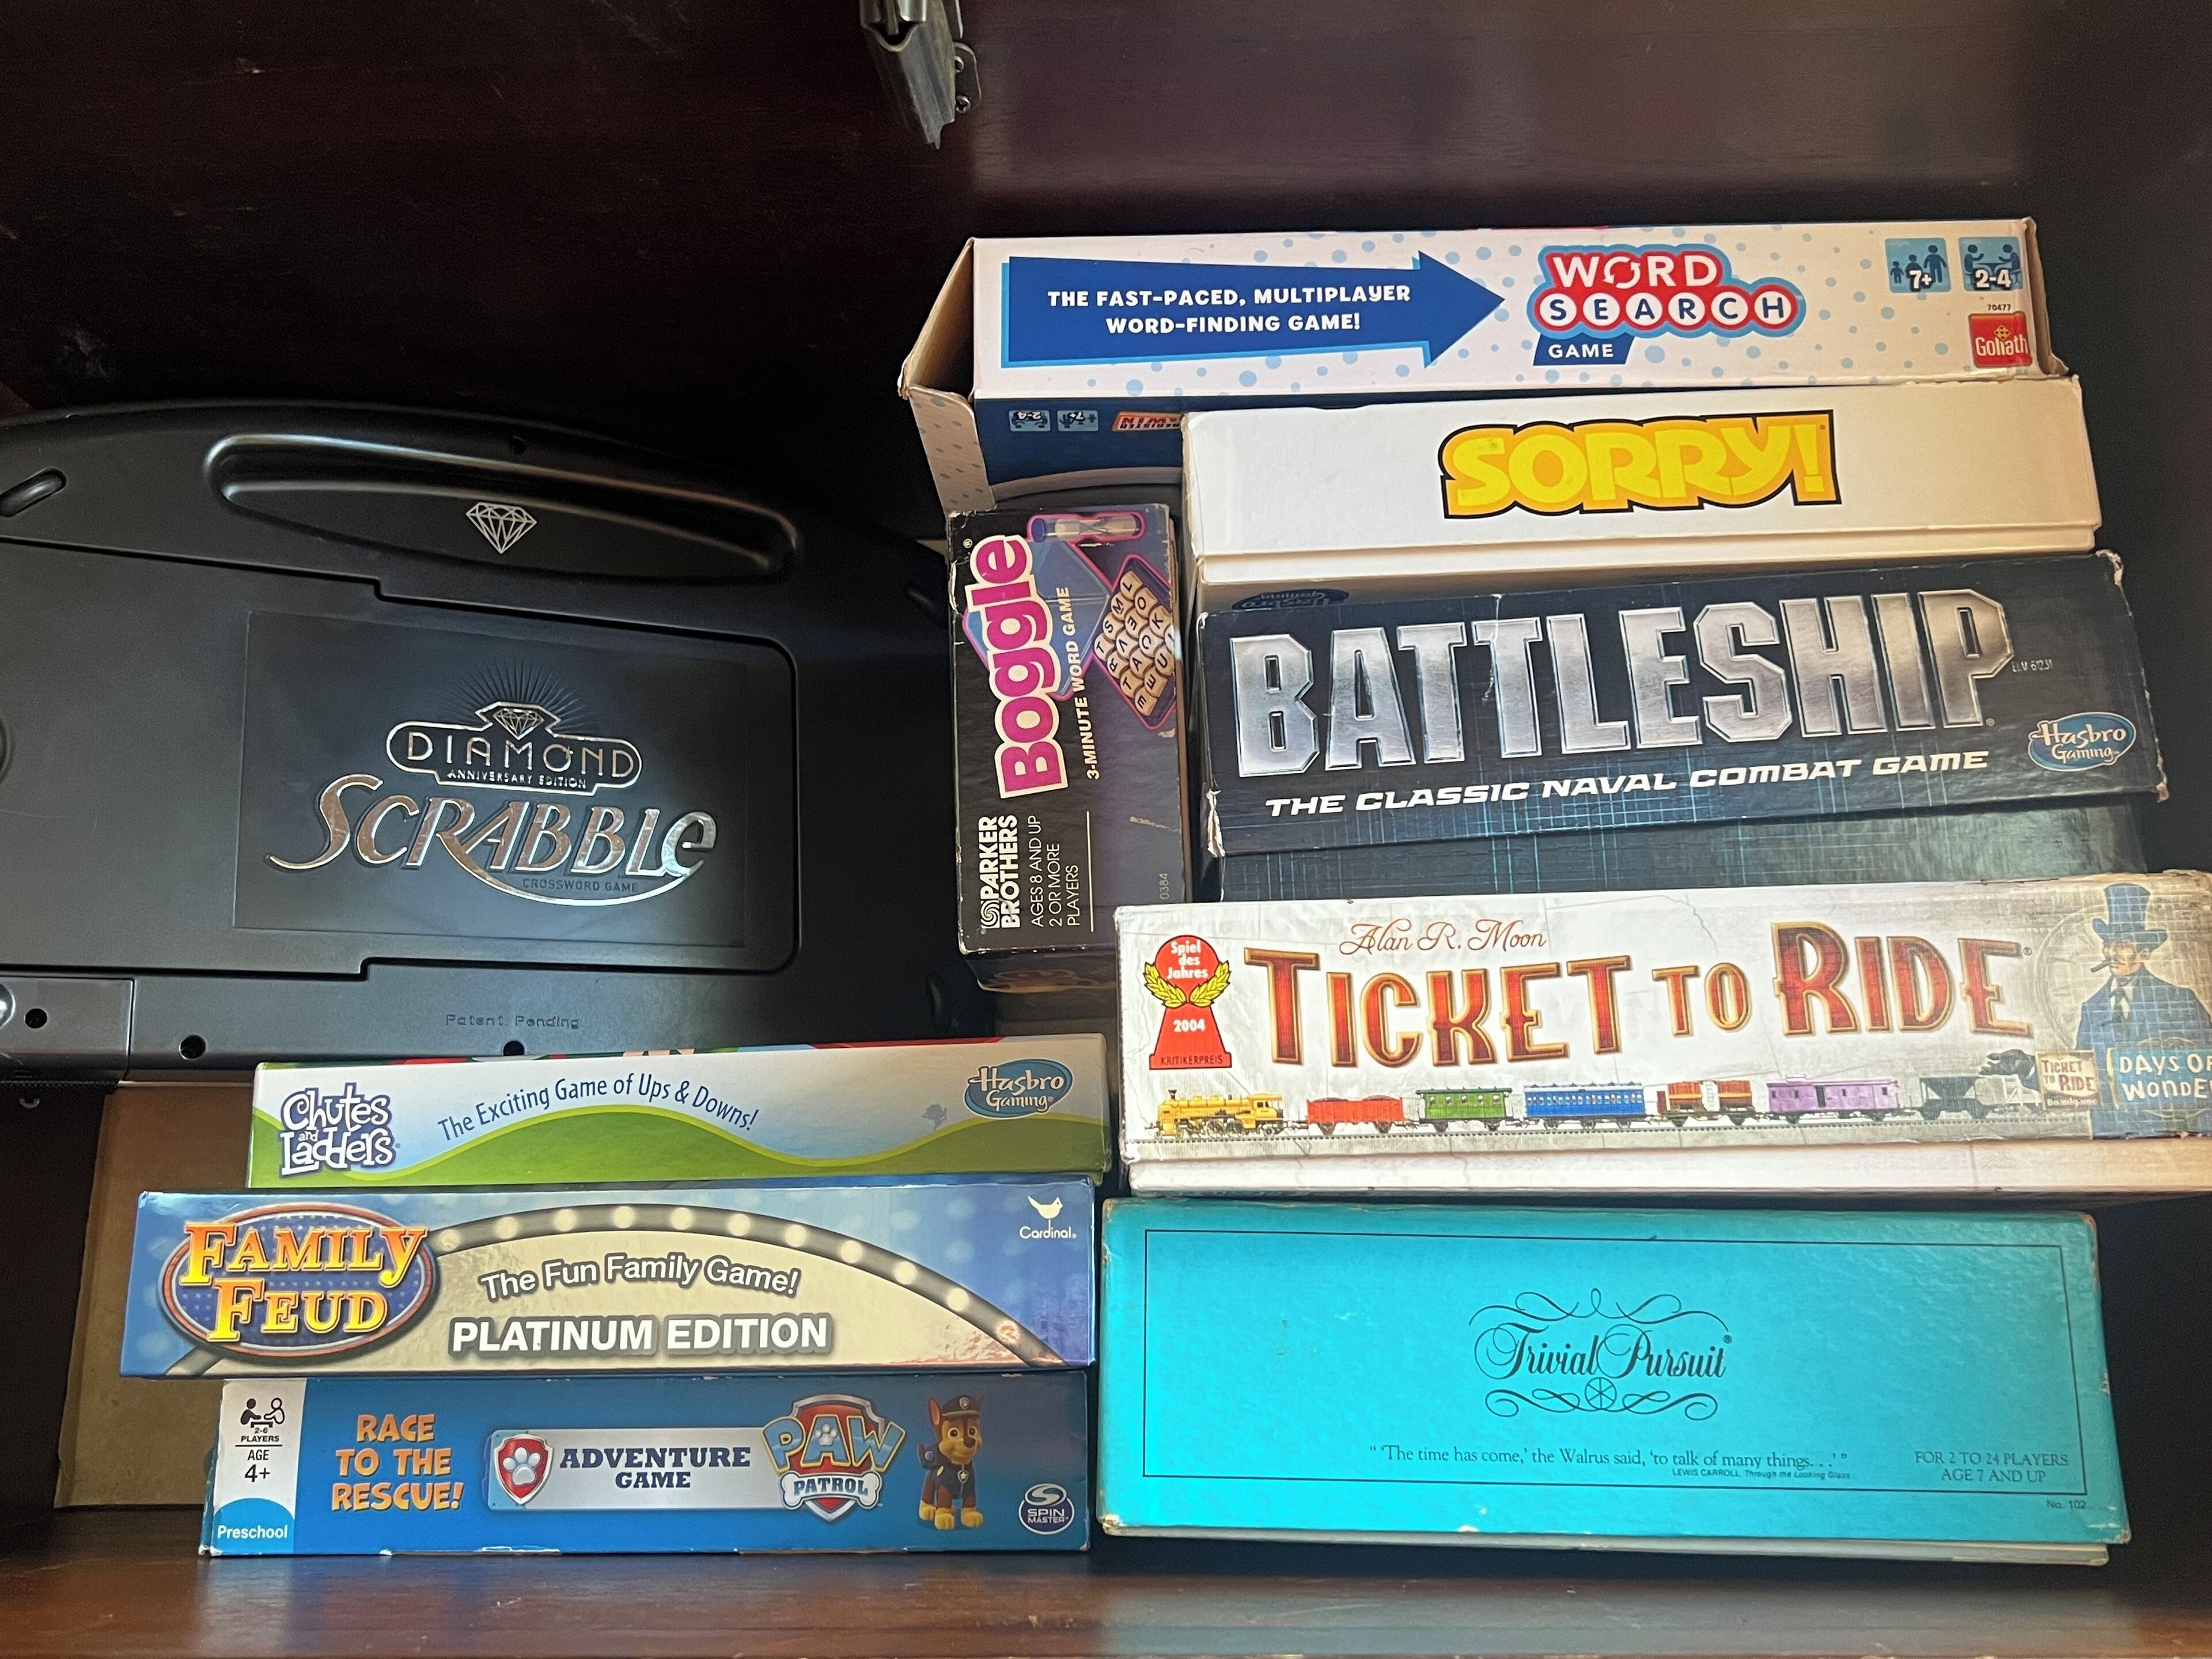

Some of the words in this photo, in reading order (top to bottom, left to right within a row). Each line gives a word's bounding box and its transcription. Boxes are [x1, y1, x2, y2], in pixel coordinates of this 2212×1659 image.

[1552, 252, 1718, 288] WORD
[1909, 270, 1932, 289] 7+
[1975, 268, 2012, 289] 2-4
[1048, 289, 1090, 307] THE
[1097, 287, 1246, 308] FAST-PACED,
[1253, 284, 1411, 304] MULTIPLAYER
[1545, 295, 1790, 323] SEARCH
[1987, 304, 2012, 312] 70477
[1105, 315, 1280, 335] WORD-FINDING
[1288, 312, 1361, 331] GAME!
[1548, 344, 1613, 359] GAME
[1975, 333, 2029, 357] Goliath
[1445, 414, 1834, 513] SORRY!
[1056, 586, 1075, 636] GAME
[965, 535, 1068, 798] Boggle
[1066, 642, 1087, 692] WORD
[1229, 588, 2015, 778] BATTLESHIP
[1075, 696, 1100, 780] 3-MINUTE
[2031, 722, 2127, 749] Hasbro
[407, 729, 635, 779] DIAMOND
[2051, 743, 2115, 764] Gaming
[446, 768, 533, 785] ANNIVERSARY
[539, 774, 587, 789] EDITION
[1266, 794, 1346, 817] THE
[1355, 781, 1531, 812] CLASSIC
[1541, 772, 1676, 799] NAVAL
[1690, 758, 1862, 789] COMBAT
[1872, 750, 1990, 776] GAME
[268, 774, 718, 882] SCRABBLE
[1028, 815, 1041, 835] UP
[978, 816, 998, 899] PARKER
[1028, 838, 1043, 872] AND
[1046, 843, 1061, 888] MORE
[998, 814, 1021, 929] BROTHERS
[1031, 874, 1043, 884] 8
[522, 877, 600, 892] CROSSWORD
[605, 882, 639, 893] GAME
[1065, 865, 1081, 926] PLAYERS
[1159, 873, 1170, 900] 0384
[1029, 887, 1044, 928] AGES
[1048, 891, 1062, 915] OR
[1048, 918, 1062, 927] 2
[1340, 918, 1412, 955] Alan
[1418, 919, 1463, 950] R.
[1467, 918, 1547, 950] Moon
[1170, 940, 1202, 957] Spiel
[1178, 955, 1200, 967] des
[1166, 966, 1209, 980] Jahres
[1243, 946, 1632, 1068] TICKET
[1651, 963, 1752, 1037] TO
[1770, 919, 2035, 1037] RIDE
[446, 1013, 505, 1027] Patent
[514, 1015, 582, 1029] Pending
[1173, 1019, 1206, 1034] 2004
[1160, 1054, 1224, 1066] KRITIKERPREIS
[2041, 1059, 2083, 1073] TICKET
[2119, 1054, 2180, 1076] DAYS
[968, 1066, 1065, 1097] Hasbro
[2058, 1074, 2096, 1092] RIDE
[2121, 1077, 2212, 1102] WONDE
[281, 1083, 393, 1129] Chutes
[437, 1116, 475, 1142] The
[475, 1086, 551, 1126] Exciting
[554, 1077, 609, 1101] Game
[613, 1073, 634, 1094] of
[638, 1072, 671, 1102] Ups
[674, 1079, 690, 1103] &
[692, 1085, 759, 1132] Downs!
[985, 1091, 1049, 1112] Gaming
[298, 1129, 320, 1143] and
[281, 1126, 396, 1177] Ladders
[1019, 1219, 1072, 1240] Cardinal
[179, 1222, 430, 1287] FAMILY
[481, 1271, 536, 1301] The
[544, 1262, 596, 1286] Fun
[607, 1256, 699, 1287] Family
[706, 1260, 801, 1296] Game!
[207, 1277, 389, 1342] FEUD
[452, 1320, 653, 1352] PLATINUM
[666, 1316, 828, 1349] EDITION
[1474, 1322, 1599, 1380] Trivial
[1596, 1323, 1727, 1379] Pursuit
[240, 1435, 281, 1443] PLAYERS
[253, 1426, 269, 1434] 2-6
[355, 1413, 436, 1442] RACE
[761, 1412, 907, 1474] PAW
[247, 1449, 270, 1461] AGE
[335, 1448, 380, 1477] TO
[392, 1448, 454, 1476] THE
[559, 1448, 752, 1469] ADVENTURE
[1418, 1446, 1450, 1462] time
[1454, 1446, 1478, 1463] has
[1531, 1448, 1555, 1464] the
[1559, 1447, 1611, 1465] Walrus
[1613, 1449, 1646, 1467] said,
[1672, 1449, 1700, 1467] talk
[1703, 1450, 1719, 1467] of
[1721, 1454, 1763, 1469] many
[1914, 1450, 1943, 1465] FOR
[1949, 1451, 1957, 1465] 2
[1959, 1451, 1983, 1466] TO
[1986, 1452, 2002, 1466] 24
[2003, 1452, 2069, 1467] PLAYERS
[244, 1465, 272, 1483] 4+
[614, 1471, 691, 1490] GAME
[1672, 1468, 1699, 1477] LEWIS
[1940, 1468, 1975, 1483] AGE
[1977, 1468, 1984, 1483] 7
[1988, 1468, 2024, 1483] AND
[2027, 1469, 2047, 1484] UP
[331, 1482, 465, 1512] RESCUE!
[793, 1476, 869, 1497] PATROL
[1027, 1508, 1066, 1517] SPIN
[2068, 1499, 2087, 1510] 102
[1027, 1514, 1066, 1525] MASTER
[217, 1524, 289, 1541] Preschool
